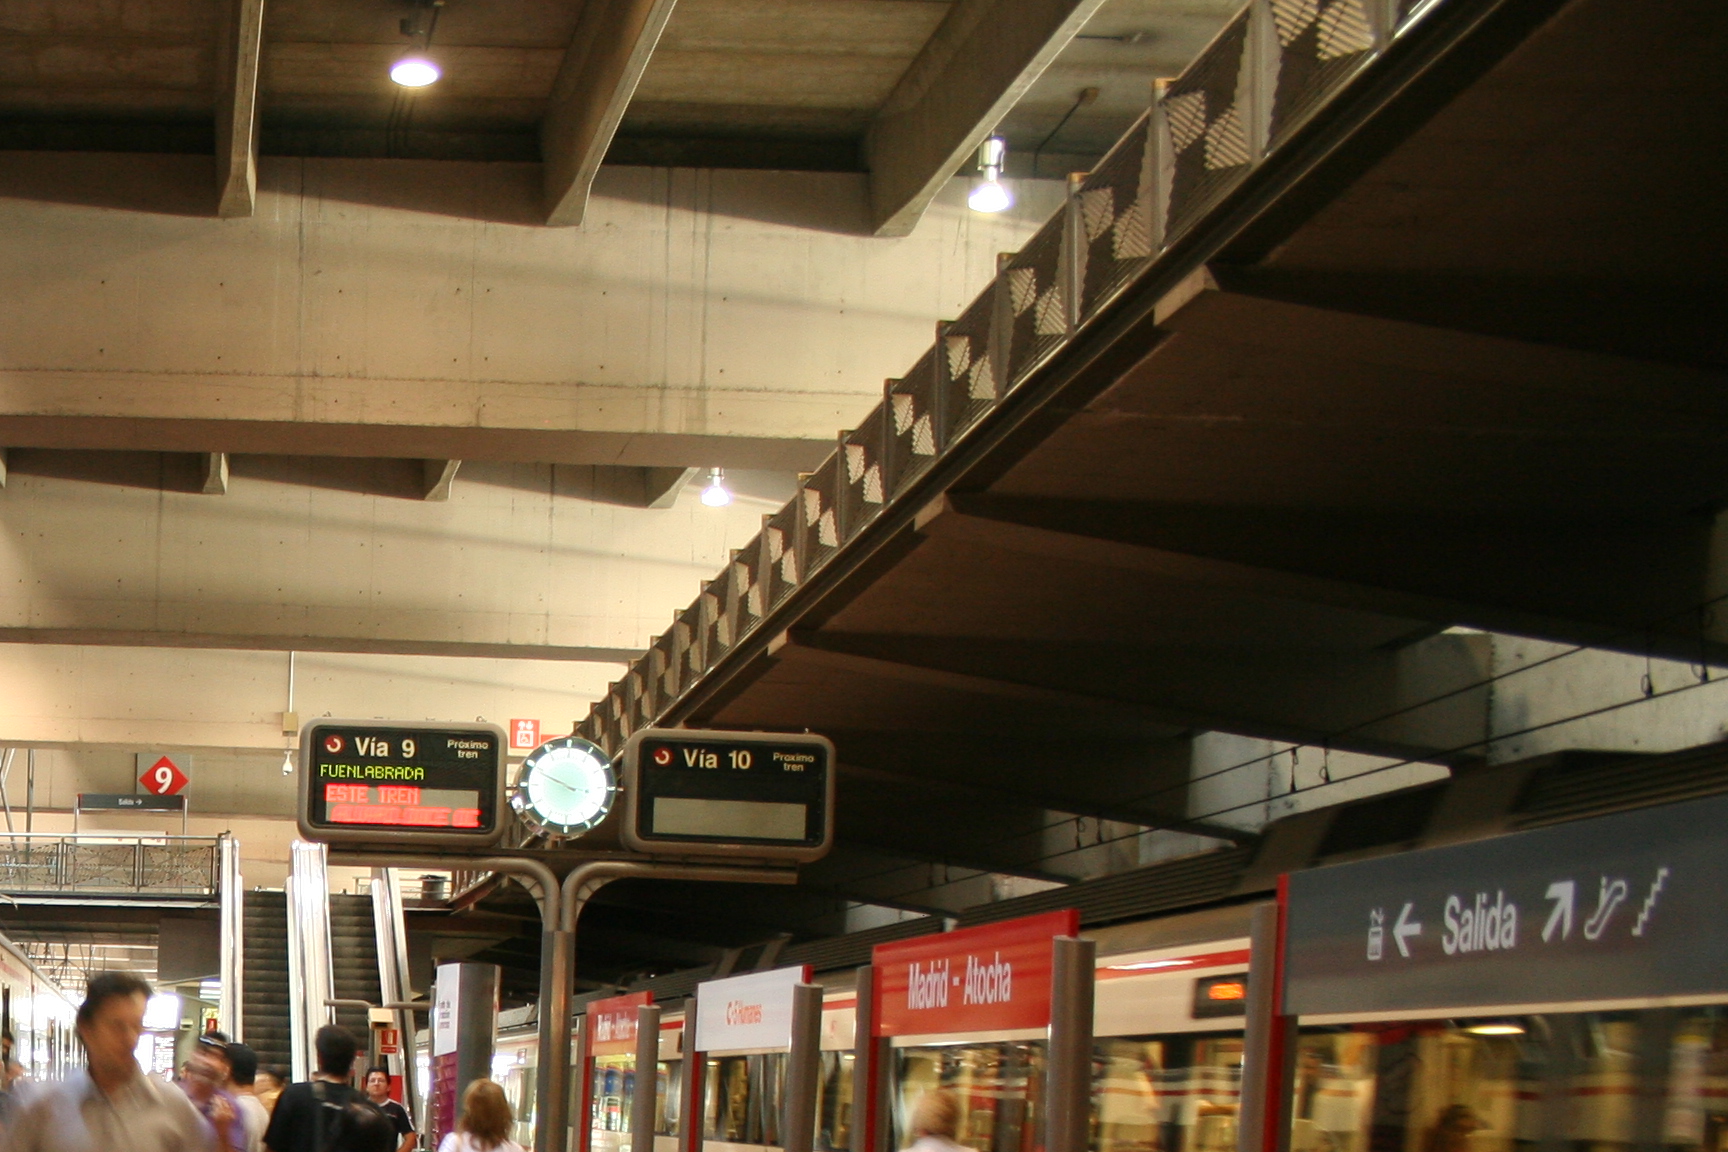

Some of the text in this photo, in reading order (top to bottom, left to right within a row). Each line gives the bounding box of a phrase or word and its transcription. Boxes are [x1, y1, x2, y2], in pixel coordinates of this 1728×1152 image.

[354, 736, 416, 759] Vía 9
[456, 750, 479, 759] tren
[683, 748, 752, 770] Vía 10
[782, 762, 804, 772] tren
[154, 766, 173, 794] 9
[319, 764, 424, 781] FUENLABRADA
[326, 784, 421, 805] ESTE TREN
[1441, 889, 1518, 956] Salida
[908, 958, 949, 1010] Madrid
[963, 951, 1012, 1006] Atocha
